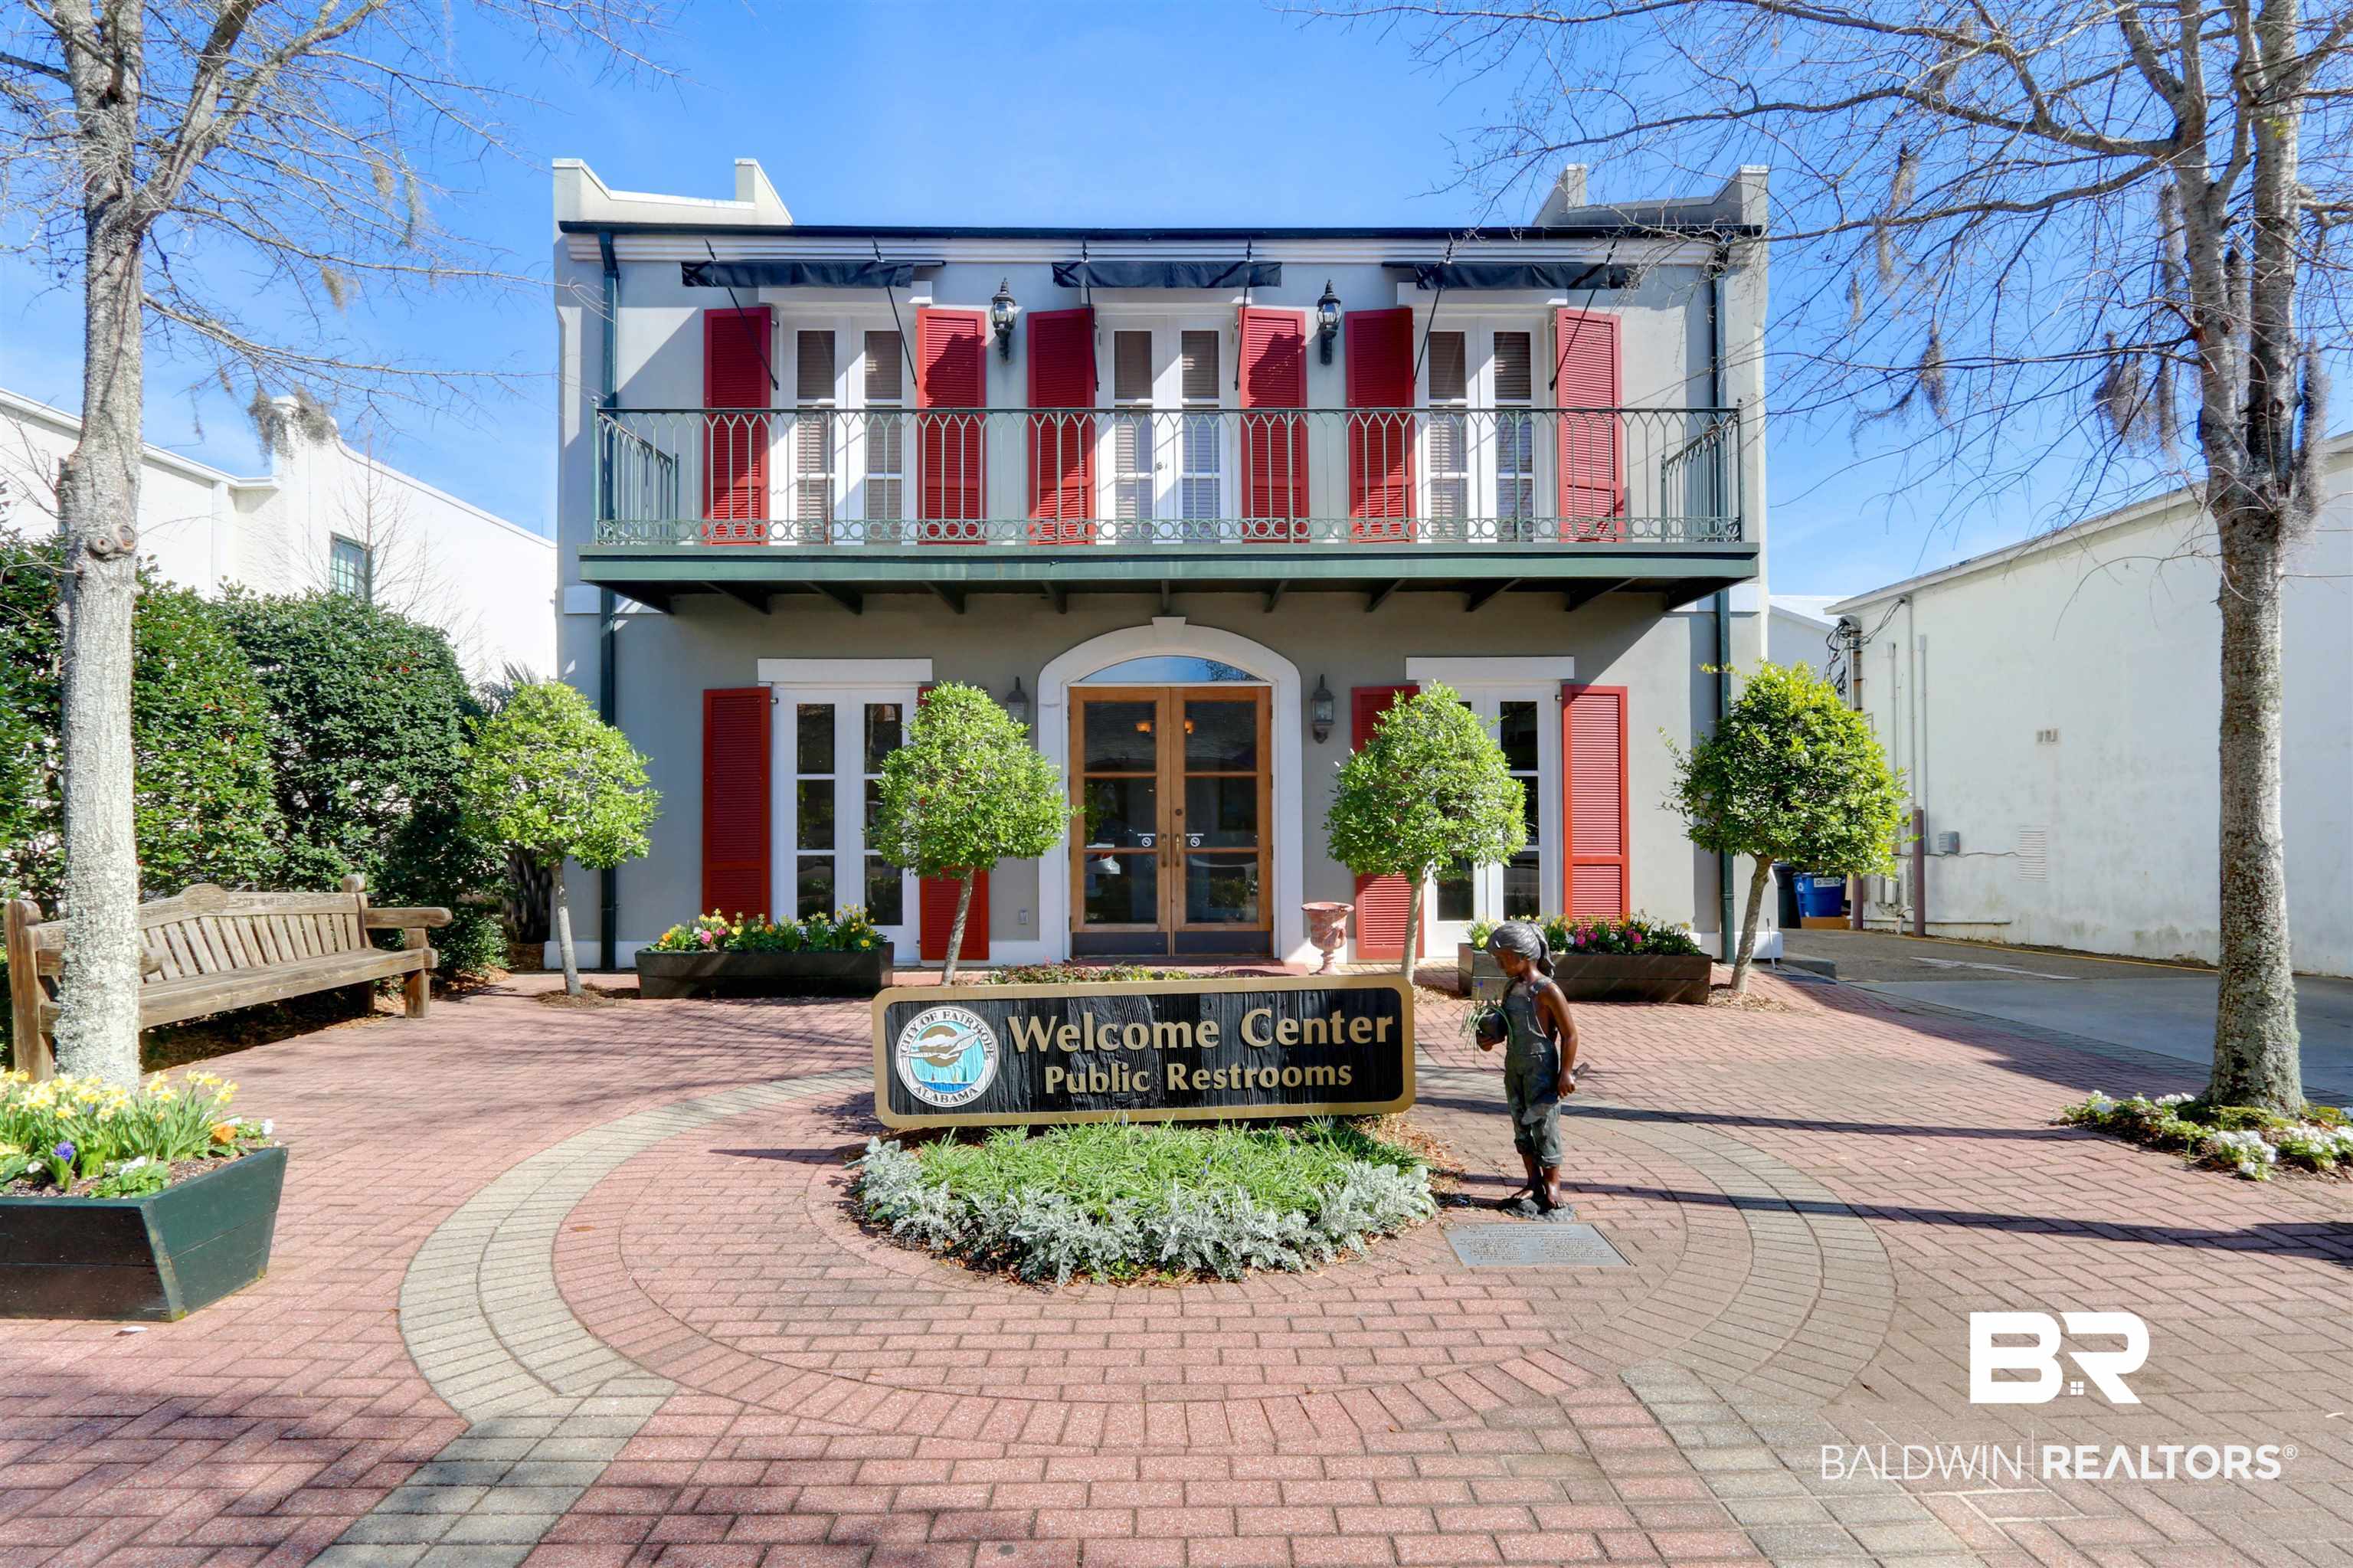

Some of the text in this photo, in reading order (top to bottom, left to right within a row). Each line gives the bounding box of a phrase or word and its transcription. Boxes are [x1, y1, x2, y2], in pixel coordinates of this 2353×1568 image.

[901, 1011, 994, 1060] CITY OF FAIRHOPE
[1008, 1008, 1393, 1052] Welcome Center
[914, 1086, 979, 1103] ALABAMA
[1045, 1062, 1353, 1095] Public Restrooms
